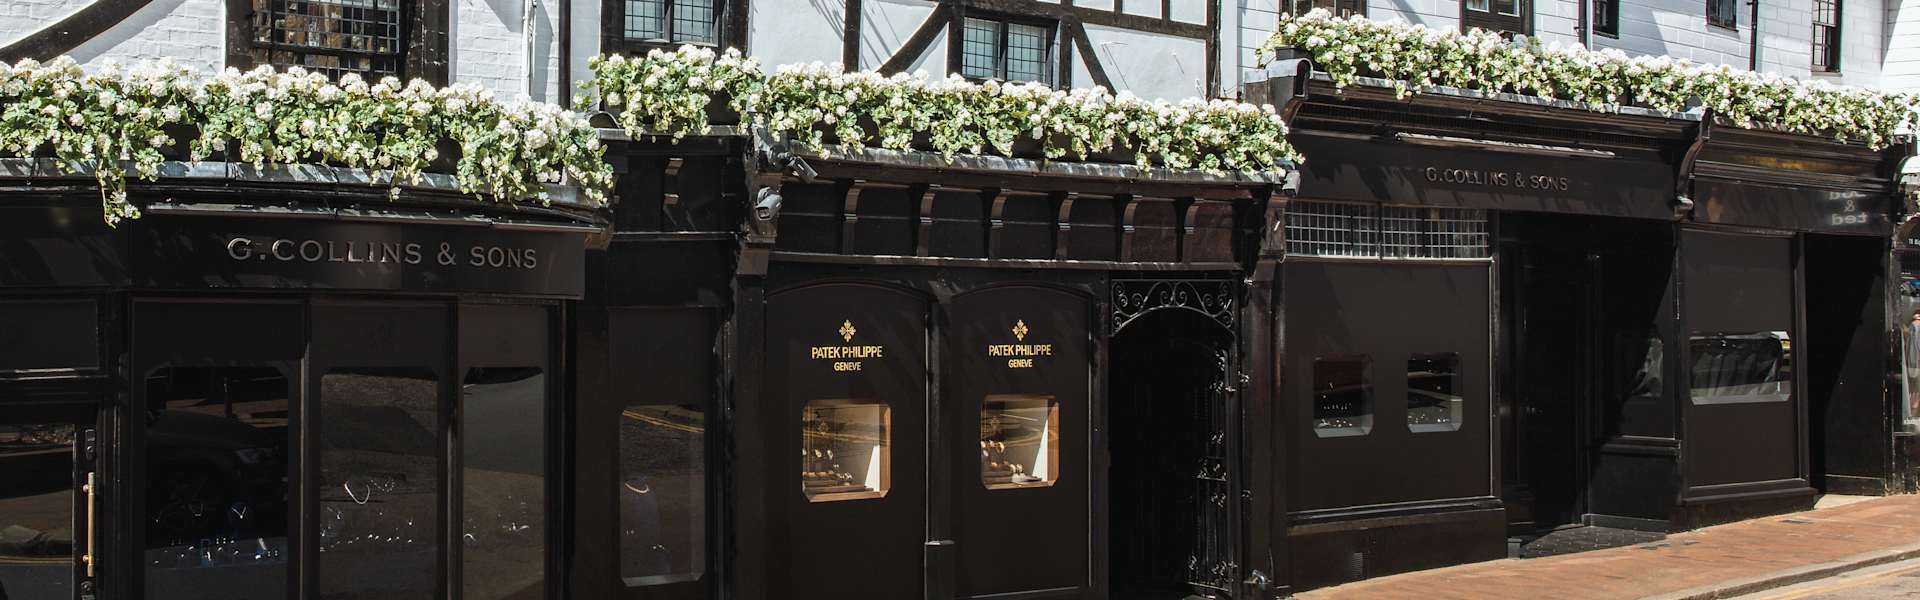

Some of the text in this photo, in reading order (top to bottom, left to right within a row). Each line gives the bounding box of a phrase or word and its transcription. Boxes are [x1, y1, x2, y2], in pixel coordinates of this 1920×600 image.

[1514, 172, 1526, 188] &
[1530, 175, 1569, 191] SONS
[437, 242, 457, 266] &
[469, 246, 538, 270] SONS
[811, 345, 883, 359] PATEK PHILIPPE
[988, 343, 1052, 356] PATEK PHILIPPE
[833, 361, 862, 371] GENEVE
[1008, 358, 1033, 368] GENEVE
